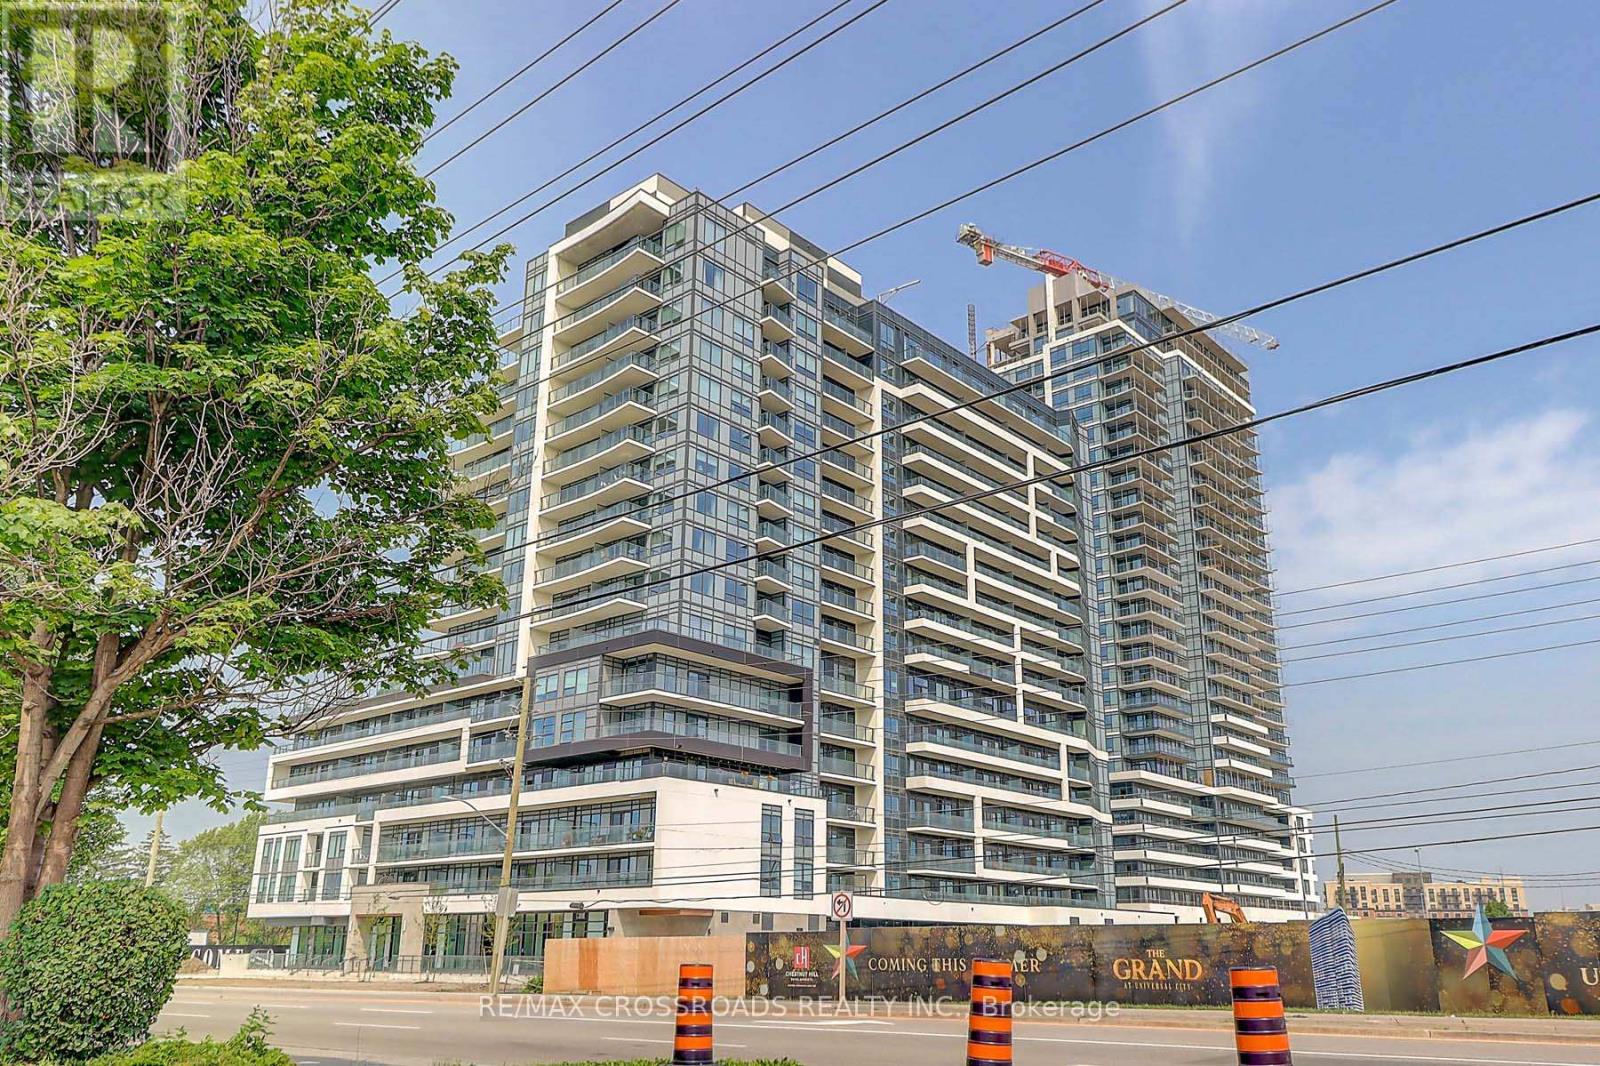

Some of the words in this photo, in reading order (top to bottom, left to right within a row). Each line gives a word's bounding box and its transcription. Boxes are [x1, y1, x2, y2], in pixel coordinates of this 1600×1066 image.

[1146, 949, 1165, 958] THE
[868, 957, 928, 972] COMING
[931, 957, 967, 972] THIS
[1112, 958, 1203, 980] GRAND
